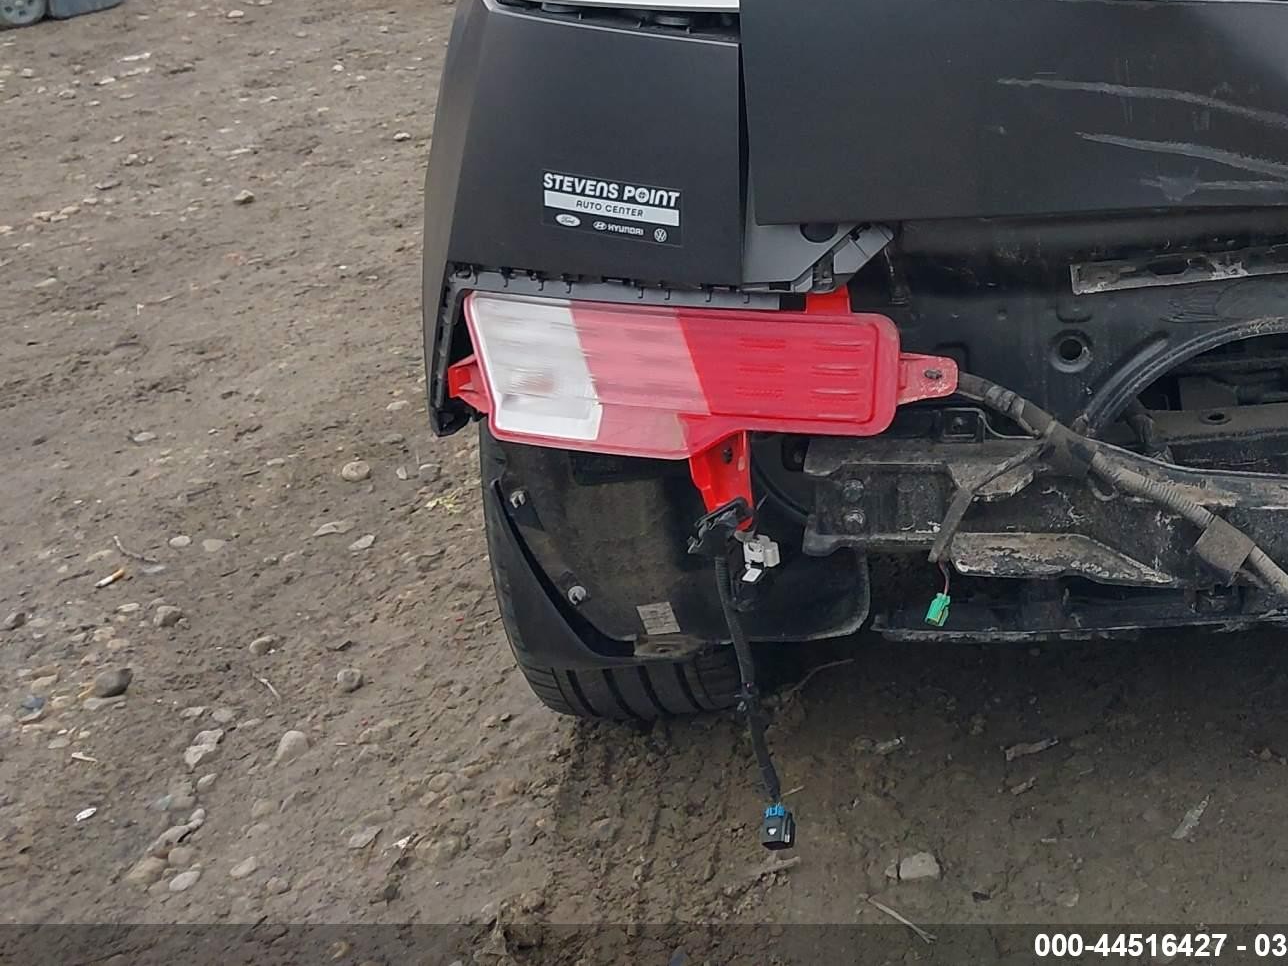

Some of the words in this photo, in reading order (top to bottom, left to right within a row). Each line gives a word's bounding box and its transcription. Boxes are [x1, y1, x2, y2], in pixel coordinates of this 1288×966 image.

[543, 172, 619, 199] STEVENS
[623, 185, 681, 207] POINT
[576, 200, 602, 211] AUTO
[605, 205, 644, 217] CENTER
[608, 224, 644, 236] HYUNDAI
